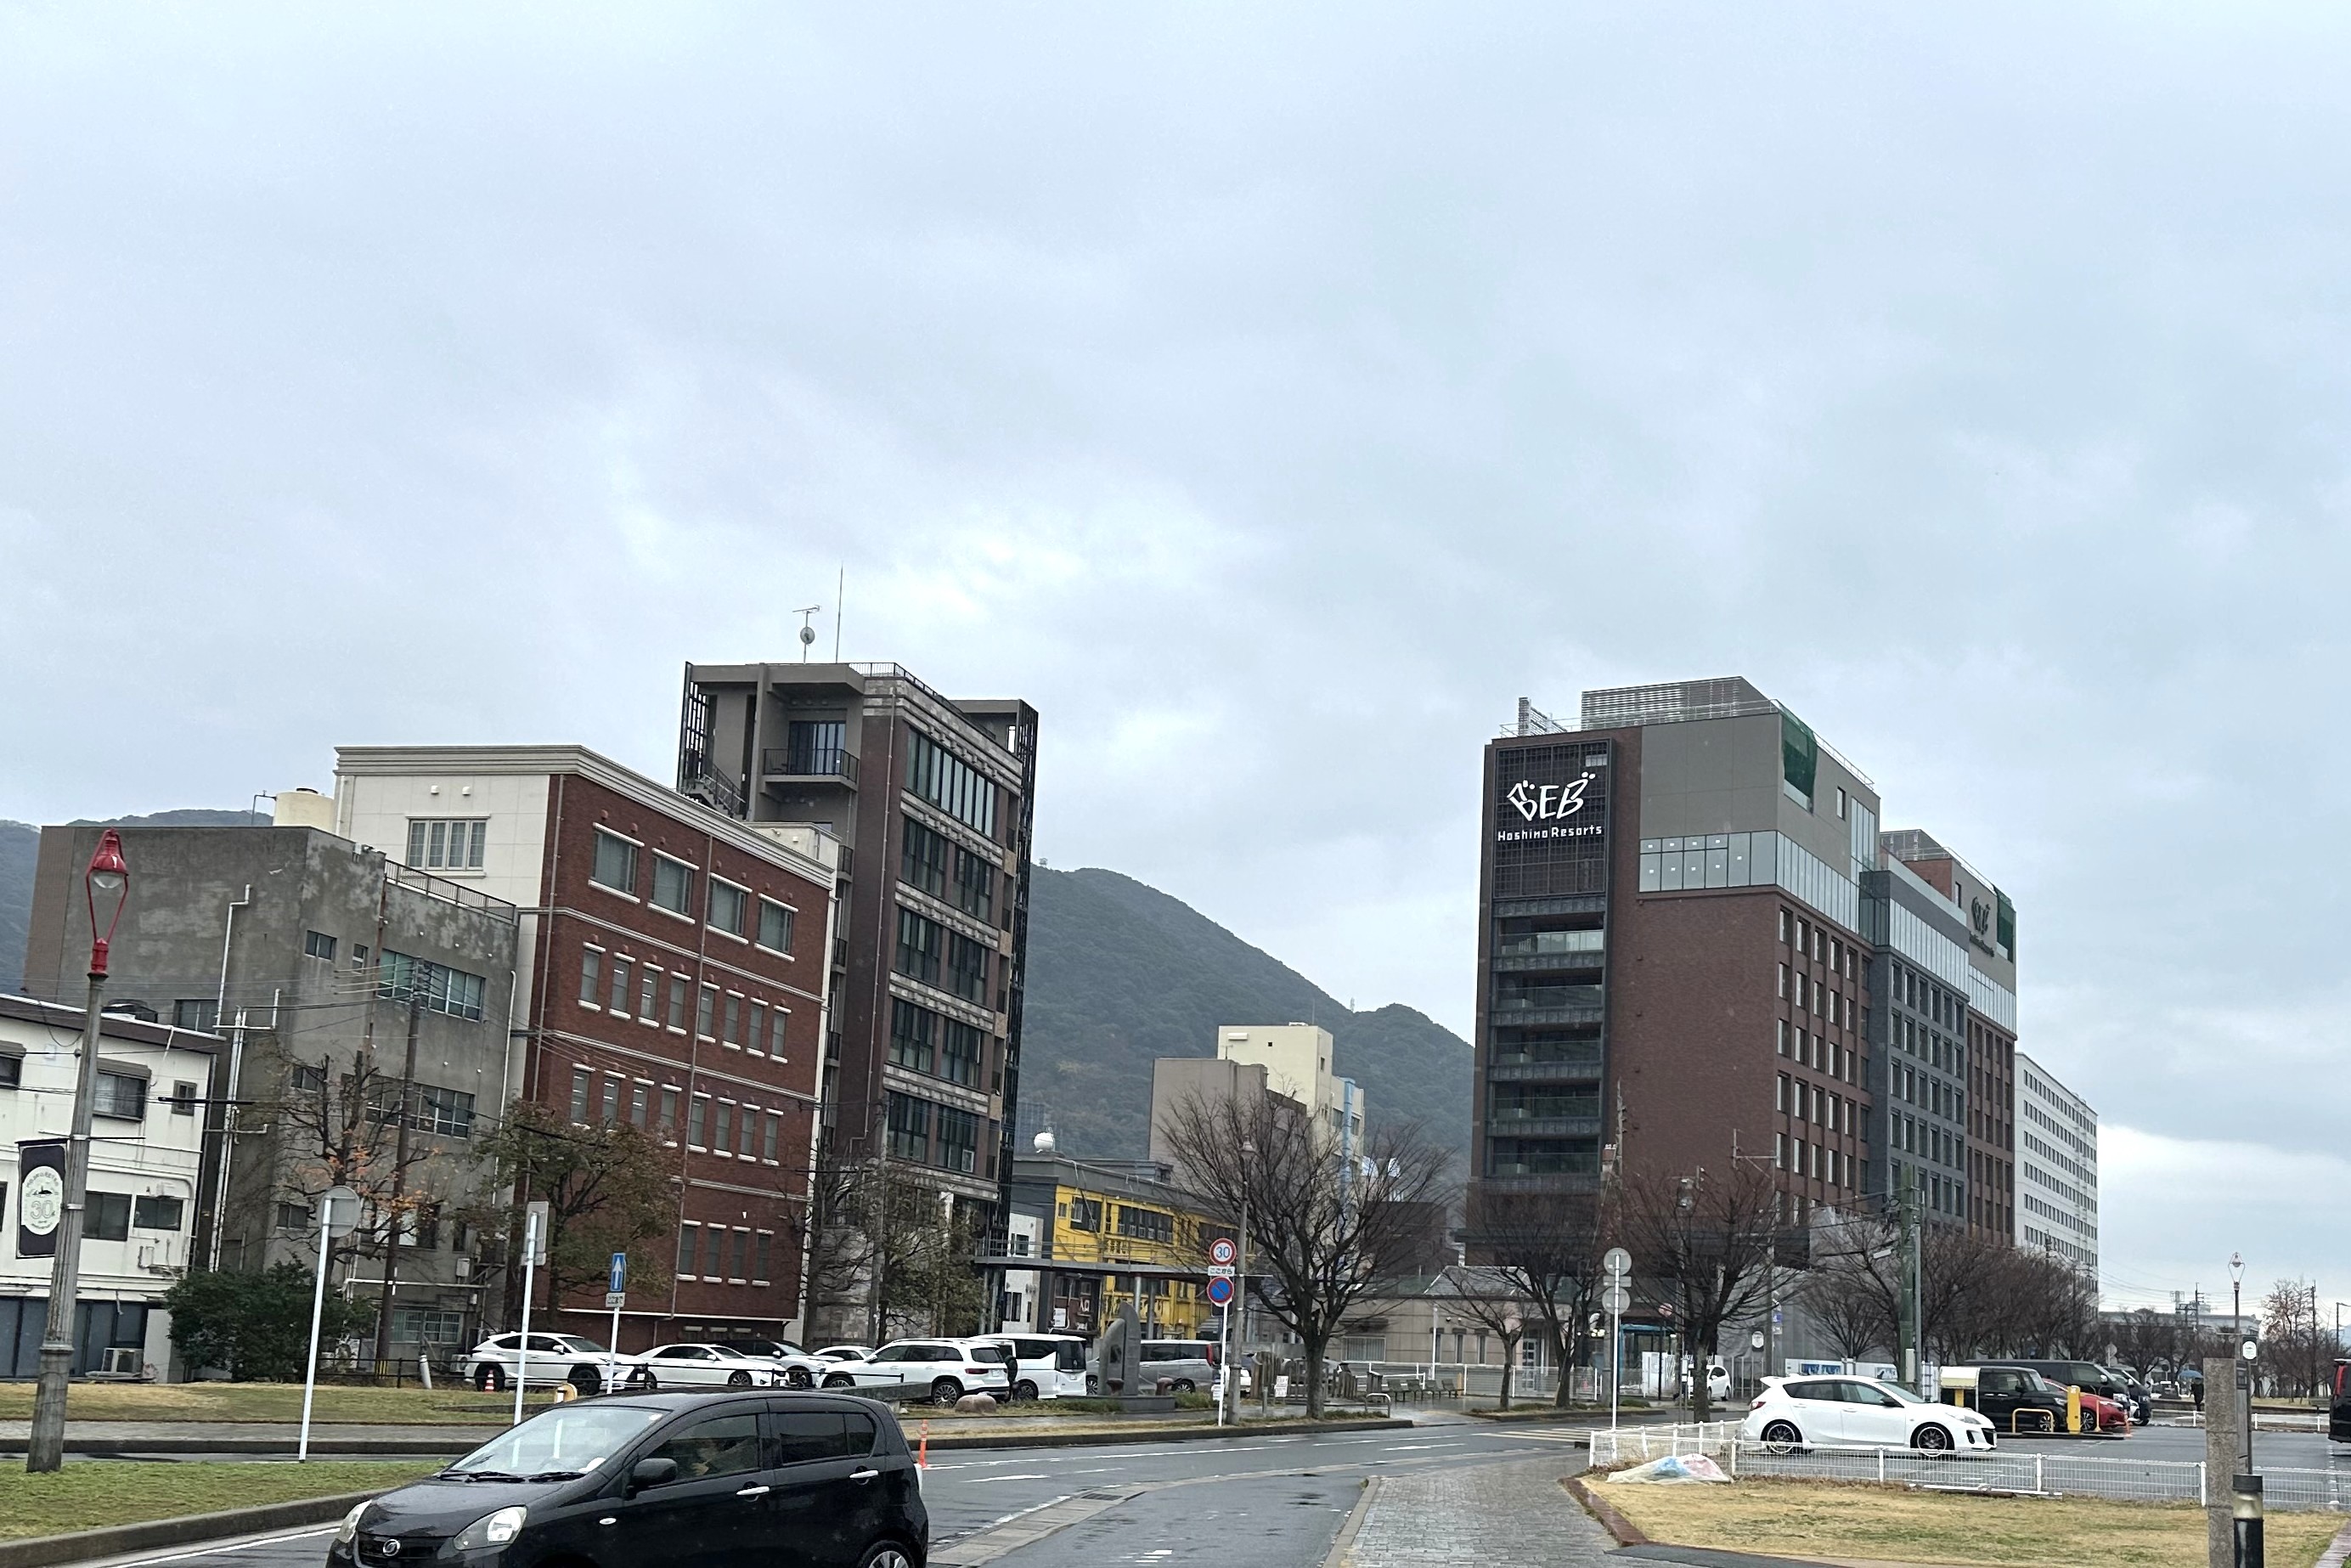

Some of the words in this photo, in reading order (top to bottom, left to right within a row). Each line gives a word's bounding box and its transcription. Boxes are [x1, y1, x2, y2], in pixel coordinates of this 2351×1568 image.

[1497, 829, 1548, 842] Hoshino
[1551, 825, 1602, 838] Resorts
[30, 1200, 54, 1219] 30
[1215, 1246, 1231, 1258] 30
